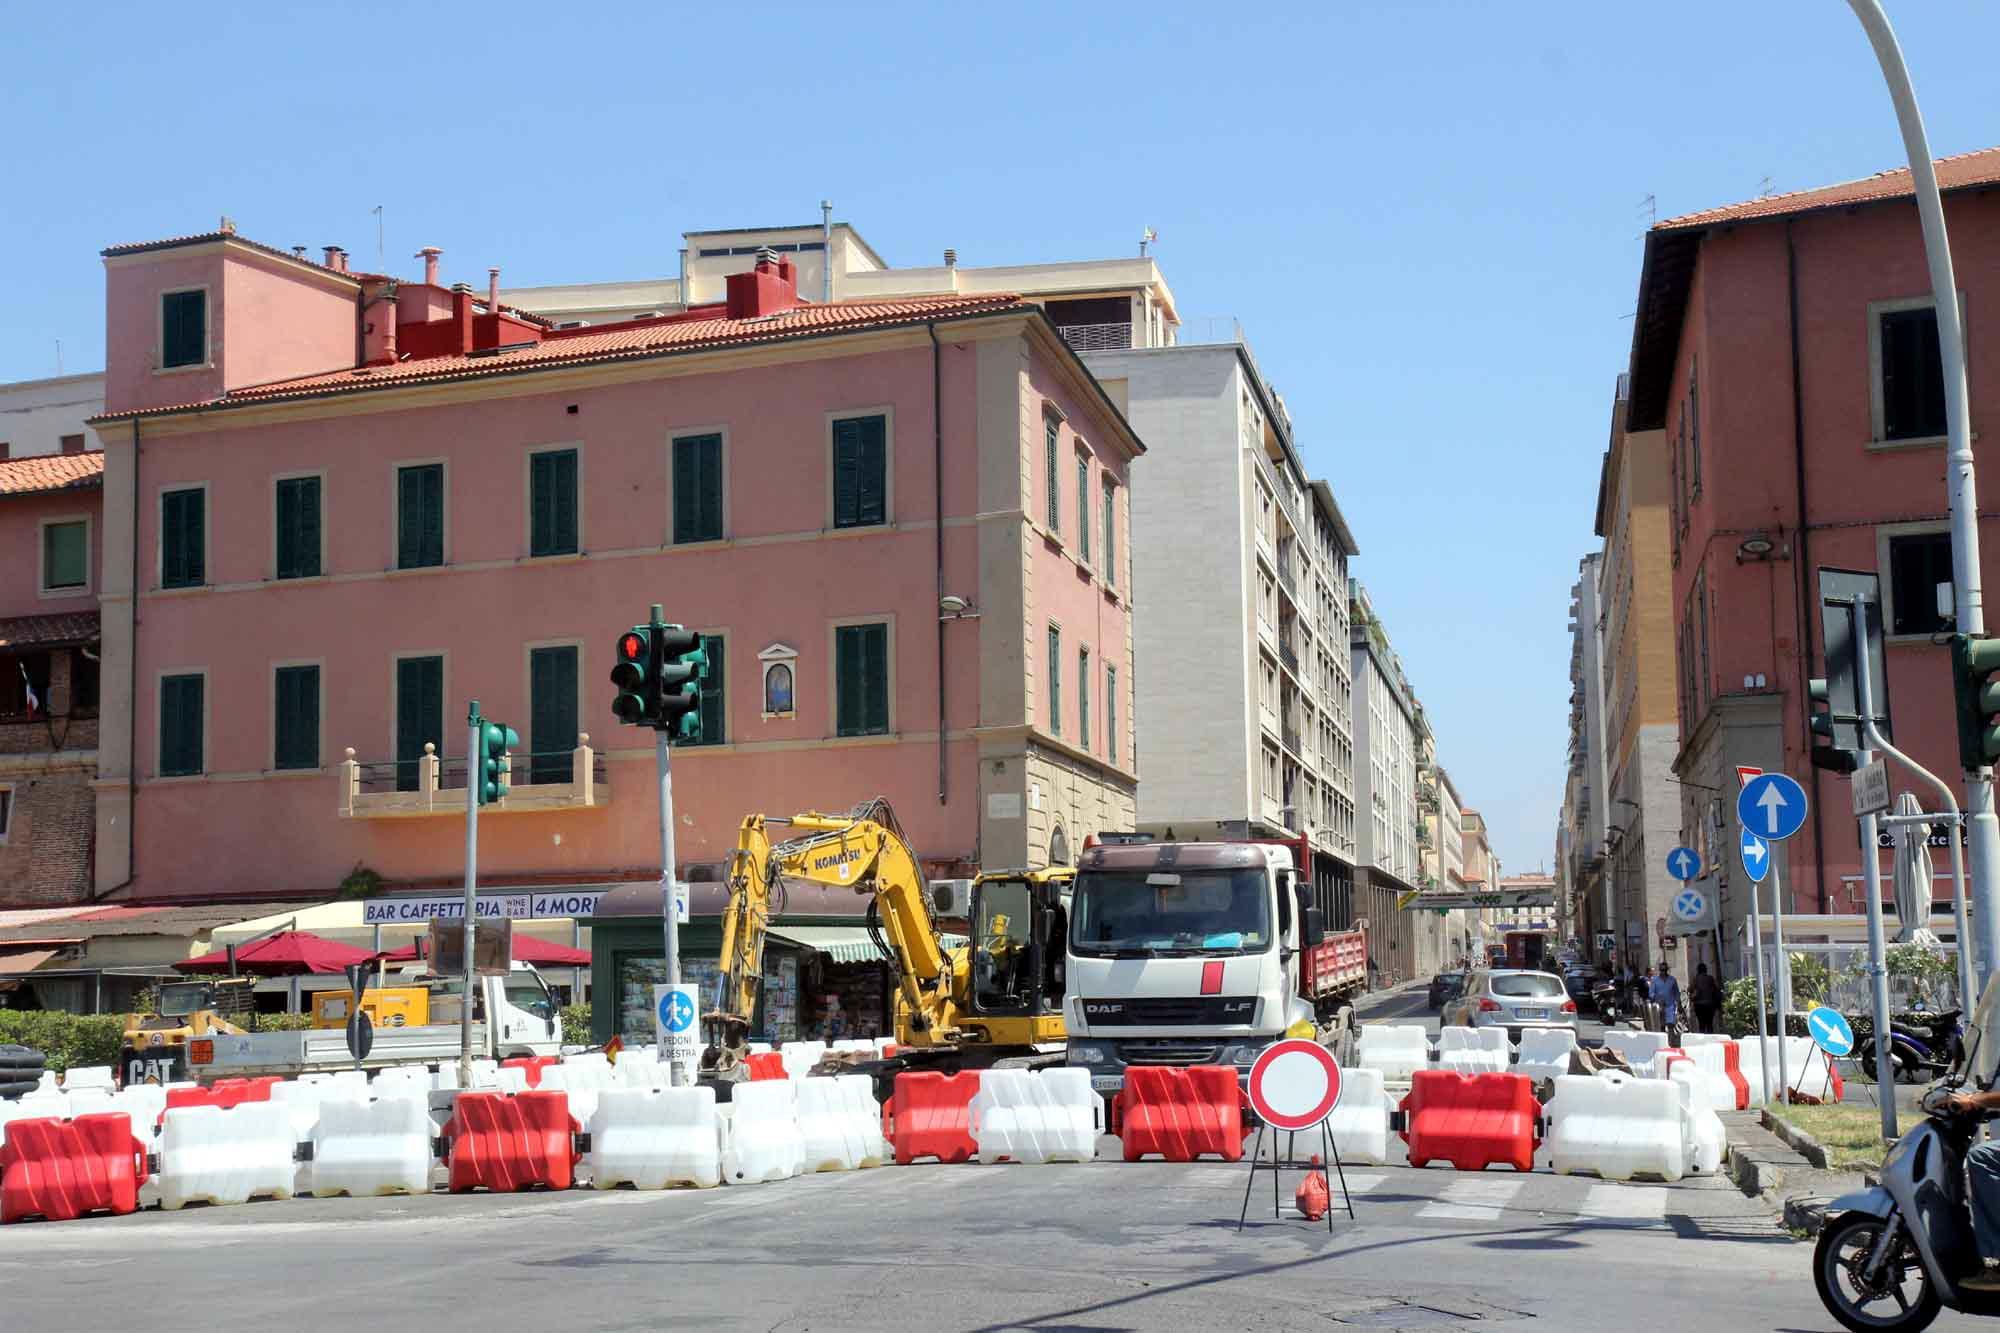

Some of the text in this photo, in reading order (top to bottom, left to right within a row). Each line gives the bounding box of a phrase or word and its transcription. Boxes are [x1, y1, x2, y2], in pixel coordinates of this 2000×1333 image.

[815, 848, 860, 870] KOMATSU
[506, 898, 526, 907] WINE
[535, 898, 546, 914] 4
[367, 901, 500, 920] BAR CAFFETTRIA
[507, 907, 525, 917] BAR
[1087, 1002, 1253, 1013] DAF LF
[663, 1036, 692, 1046] PEDONI
[660, 1048, 697, 1058] A DESTRA
[129, 1058, 175, 1087] CAT
